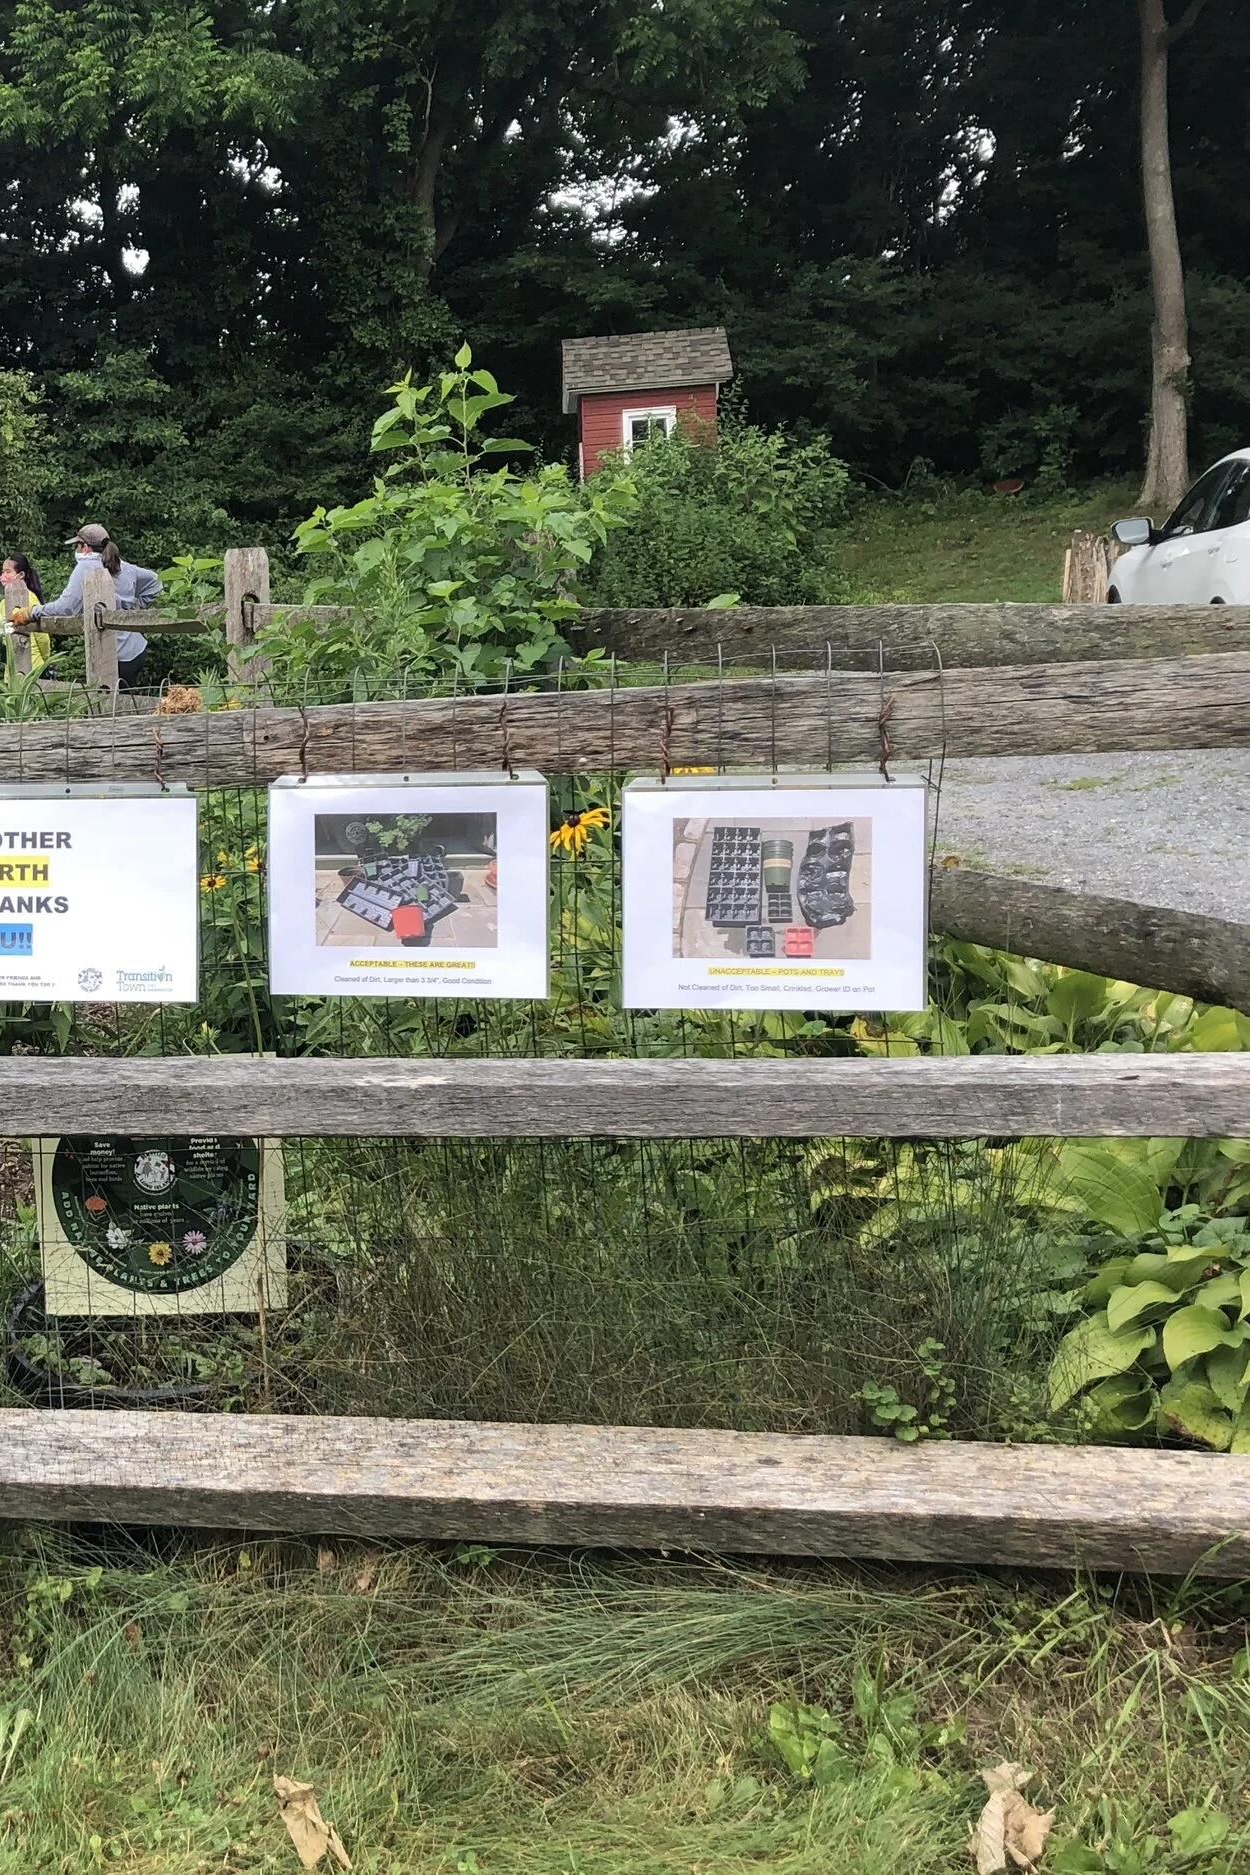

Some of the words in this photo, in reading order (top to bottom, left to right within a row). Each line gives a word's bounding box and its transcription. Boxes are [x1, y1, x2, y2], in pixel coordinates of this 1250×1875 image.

[350, 960, 397, 968] ACCEPTABLE
[116, 969, 173, 982] Transition
[800, 968, 818, 976] AND
[384, 976, 404, 984] Larger
[116, 981, 146, 992] Town
[730, 984, 744, 992] Dirt,
[783, 985, 814, 993] Crinkled,
[61, 1191, 74, 1218] ADD
